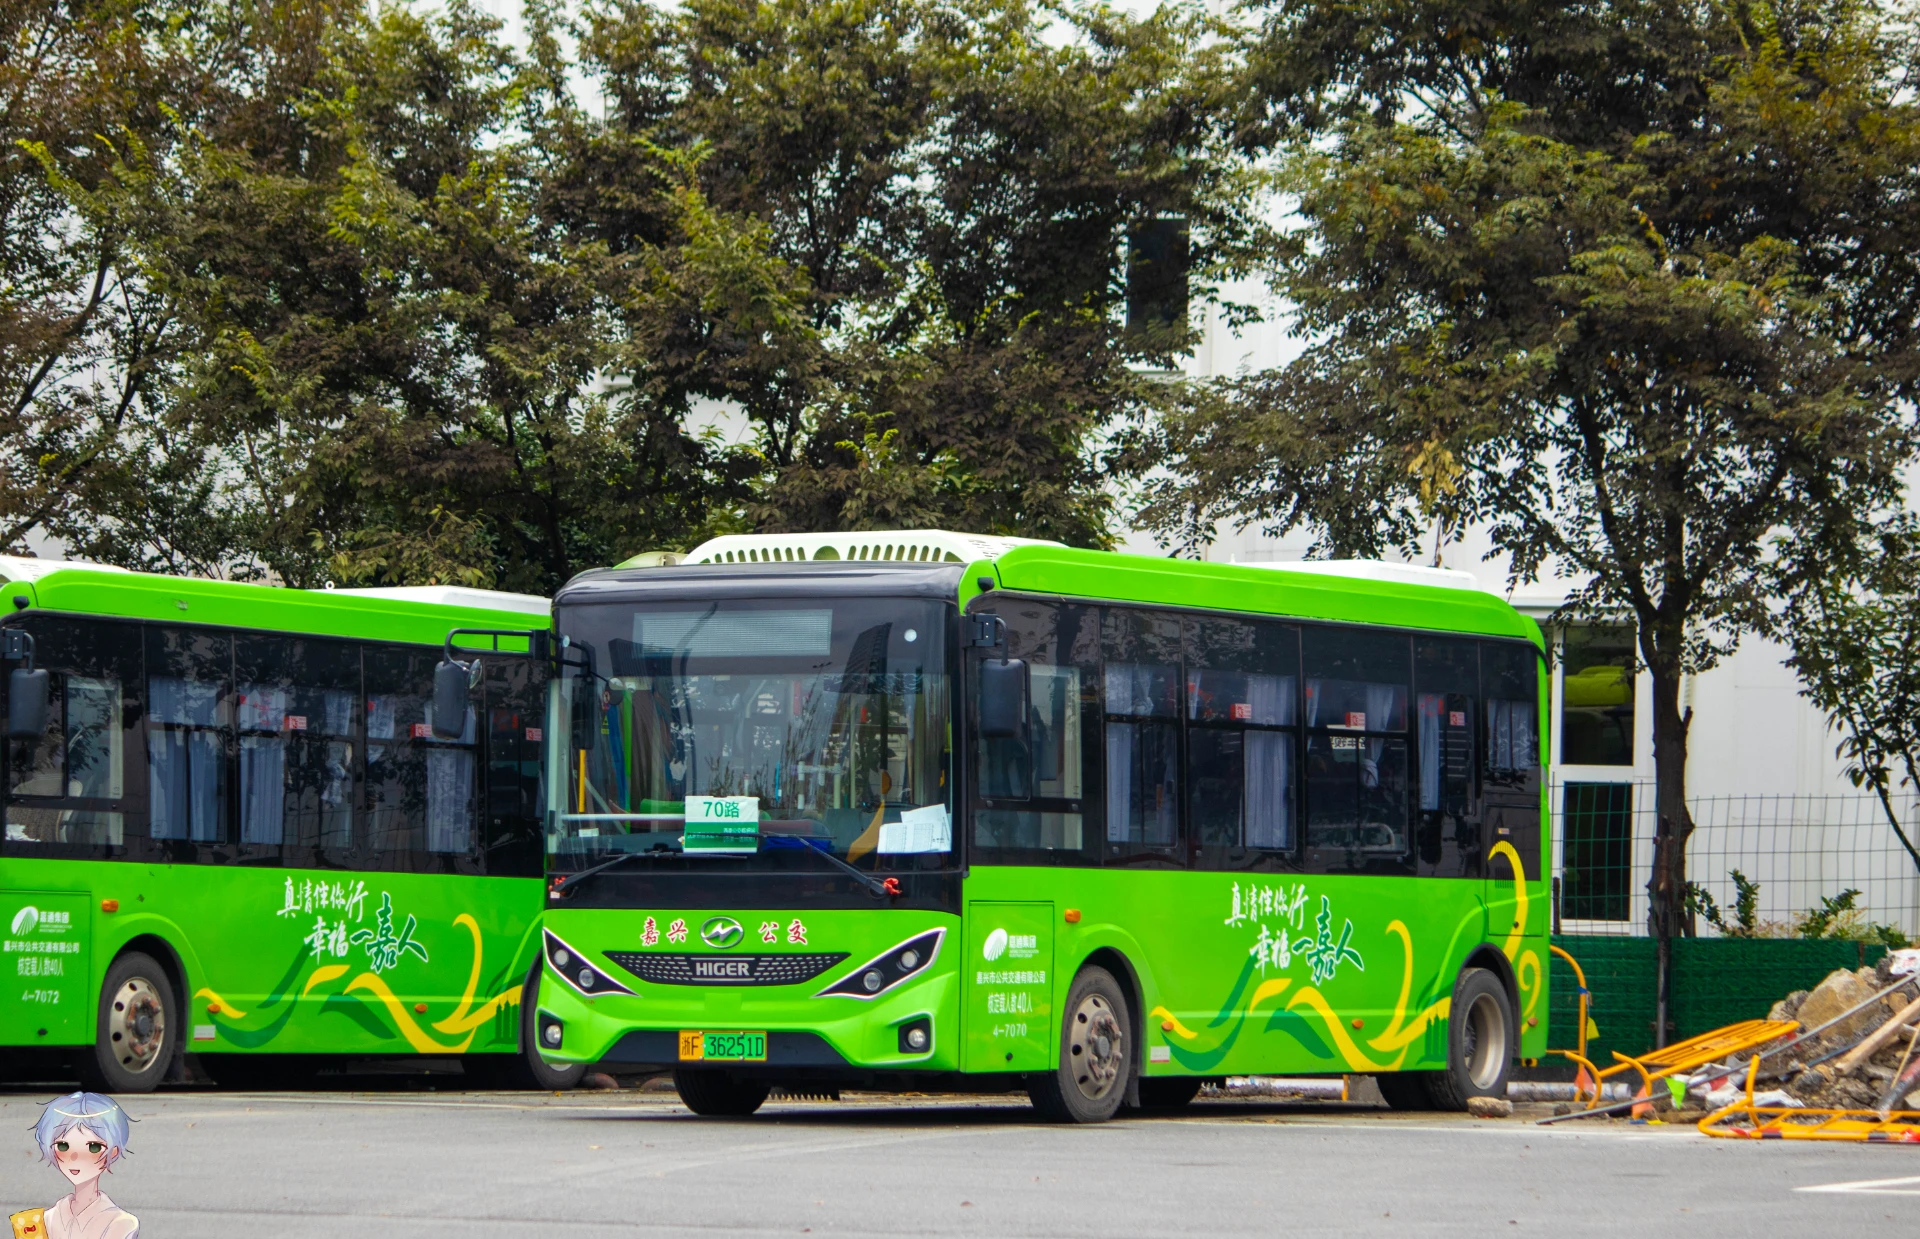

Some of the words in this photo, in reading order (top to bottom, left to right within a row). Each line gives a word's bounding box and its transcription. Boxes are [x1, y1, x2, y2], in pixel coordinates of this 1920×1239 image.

[703, 801, 740, 818] 70路
[276, 875, 369, 923] 真情伴你行
[1224, 881, 1309, 931] 真情伴你行
[303, 891, 429, 974] 幸福一嘉人
[641, 916, 689, 946] 嘉兴
[758, 919, 808, 945] 公交
[1249, 894, 1365, 987] 幸福一嘉人
[3, 940, 80, 954] 嘉兴市公共交通有限公司
[17, 956, 64, 976] 核定载人数40人
[695, 962, 750, 976] HIGER
[976, 971, 1046, 984] 嘉兴市公共交通有限公司
[22, 989, 60, 1005] 4-7072
[988, 992, 1032, 1014] 核定载人数40人
[993, 1023, 1027, 1038] 4-7070
